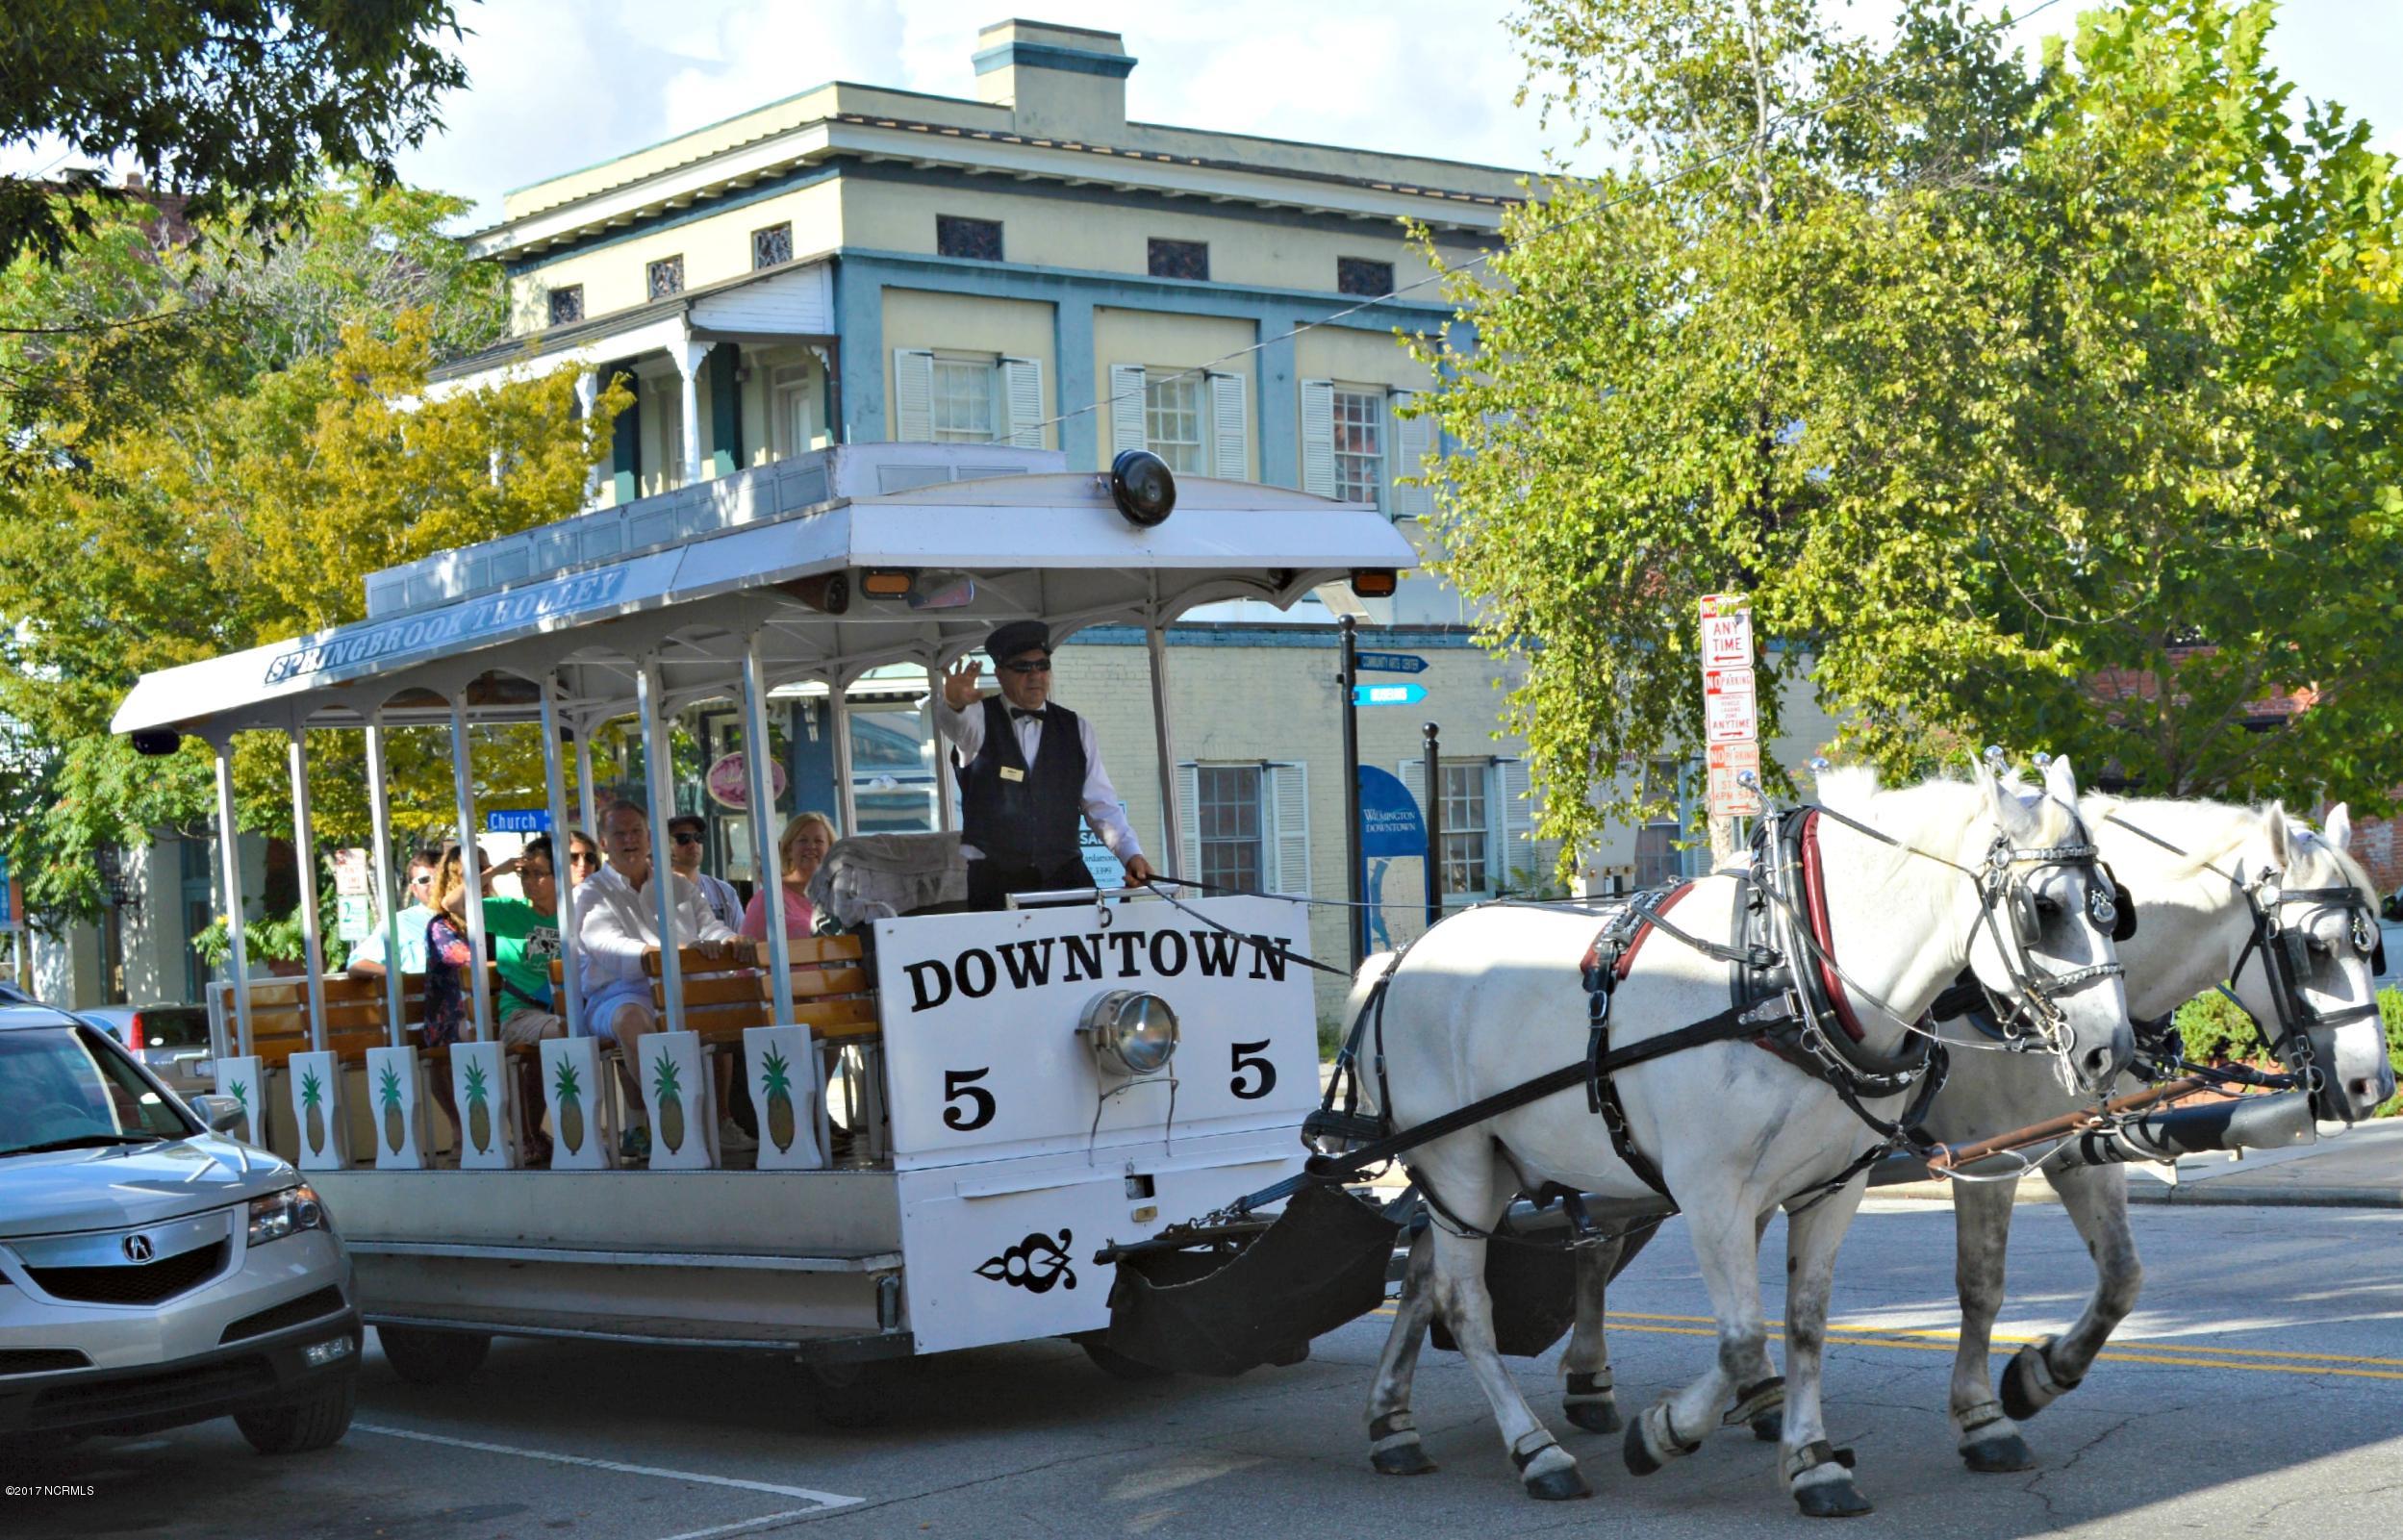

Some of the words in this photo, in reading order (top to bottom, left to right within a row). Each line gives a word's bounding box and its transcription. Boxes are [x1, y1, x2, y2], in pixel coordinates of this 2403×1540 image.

[267, 609, 468, 682] SPRINGBROOK
[475, 572, 620, 628] TROLLEY
[1713, 621, 1738, 635] ANY
[1713, 637, 1742, 651] TIME
[1707, 675, 1721, 689] NO
[1721, 676, 1752, 686] PARKING
[1712, 719, 1751, 729] ANYTIME
[1711, 750, 1725, 764] NO
[490, 812, 537, 830] Church
[1365, 822, 1416, 833] DOWNTOWN
[342, 901, 352, 922] 2
[902, 928, 1292, 1013] DOWNTOWN
[943, 1067, 997, 1131] 5
[1230, 1038, 1277, 1100] 5
